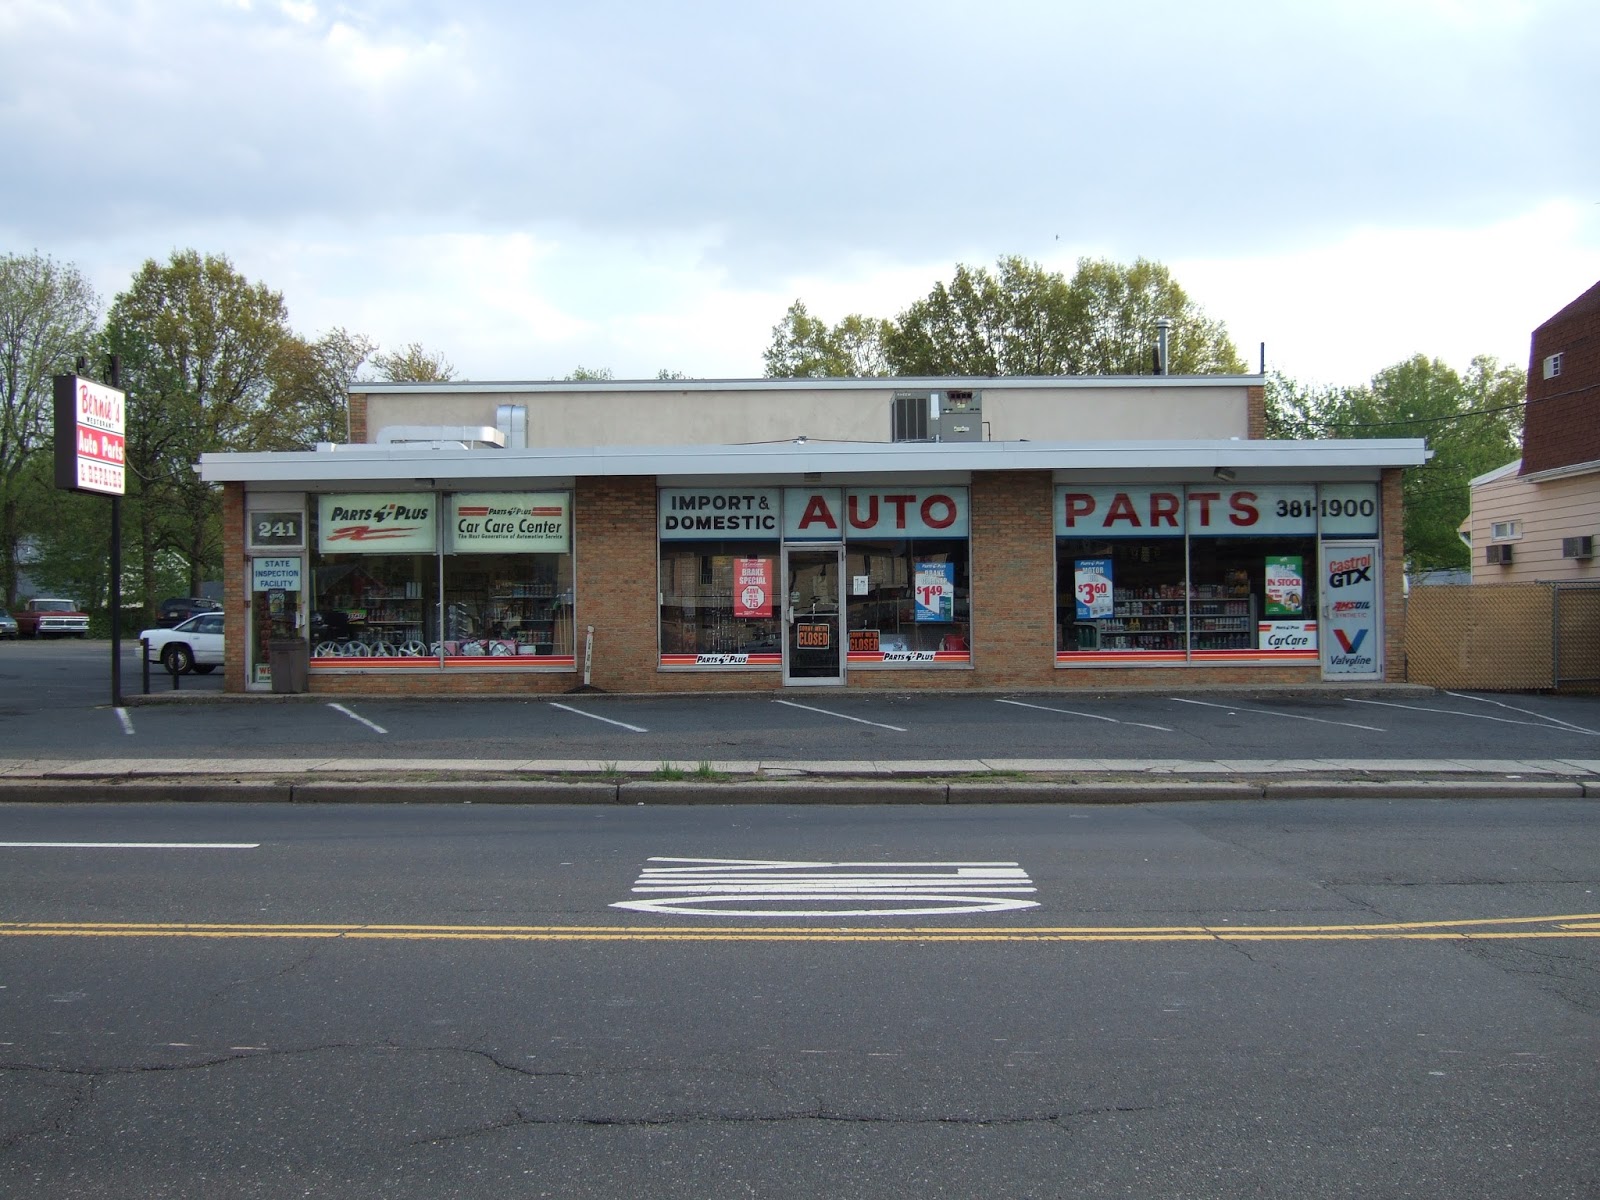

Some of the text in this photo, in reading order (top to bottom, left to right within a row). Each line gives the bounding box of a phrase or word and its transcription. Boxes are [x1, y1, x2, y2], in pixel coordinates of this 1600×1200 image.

[78, 430, 123, 461] Auto Parts
[671, 496, 770, 511] IMPORT &
[1065, 491, 1259, 527] PARTS
[331, 506, 428, 521] PARTS PLUS
[798, 494, 957, 530] AUTO
[259, 522, 296, 537] 241
[458, 518, 562, 533] Car Care Center
[665, 516, 776, 530] DOMESTIC
[265, 560, 290, 568] STATE
[1330, 554, 1371, 574] Castrol
[742, 568, 764, 576] BRAKE
[1329, 566, 1371, 588] GTX
[739, 576, 767, 585] SPECIAL
[1267, 578, 1301, 586] IN STOCK
[1332, 602, 1371, 612] AMSOIL
[799, 632, 828, 646] CLOSED
[849, 638, 879, 651] CLOSED
[696, 655, 747, 664] PARTS PLUS
[883, 652, 934, 661] PARTS PLUS
[1330, 655, 1372, 667] Valvoline
